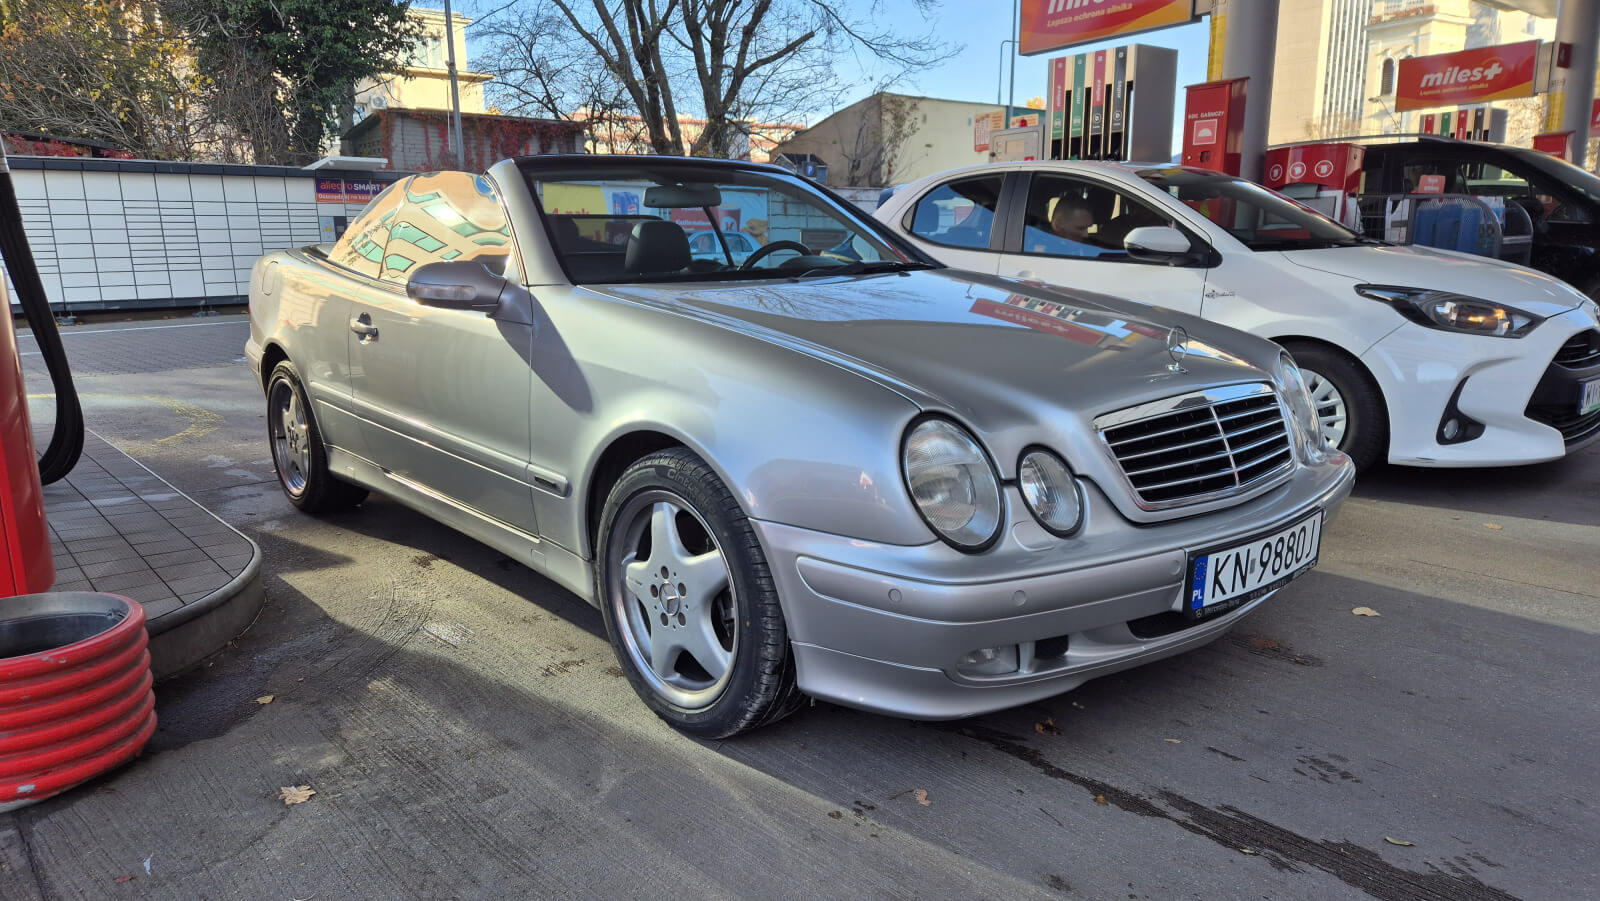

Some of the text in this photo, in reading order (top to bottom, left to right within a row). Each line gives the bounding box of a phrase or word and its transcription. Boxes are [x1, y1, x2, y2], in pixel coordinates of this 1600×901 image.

[1074, 9, 1106, 22] ochrona
[1420, 62, 1503, 88] miles+
[1211, 519, 1316, 600] KN 9880J
[1192, 589, 1203, 602] PL
